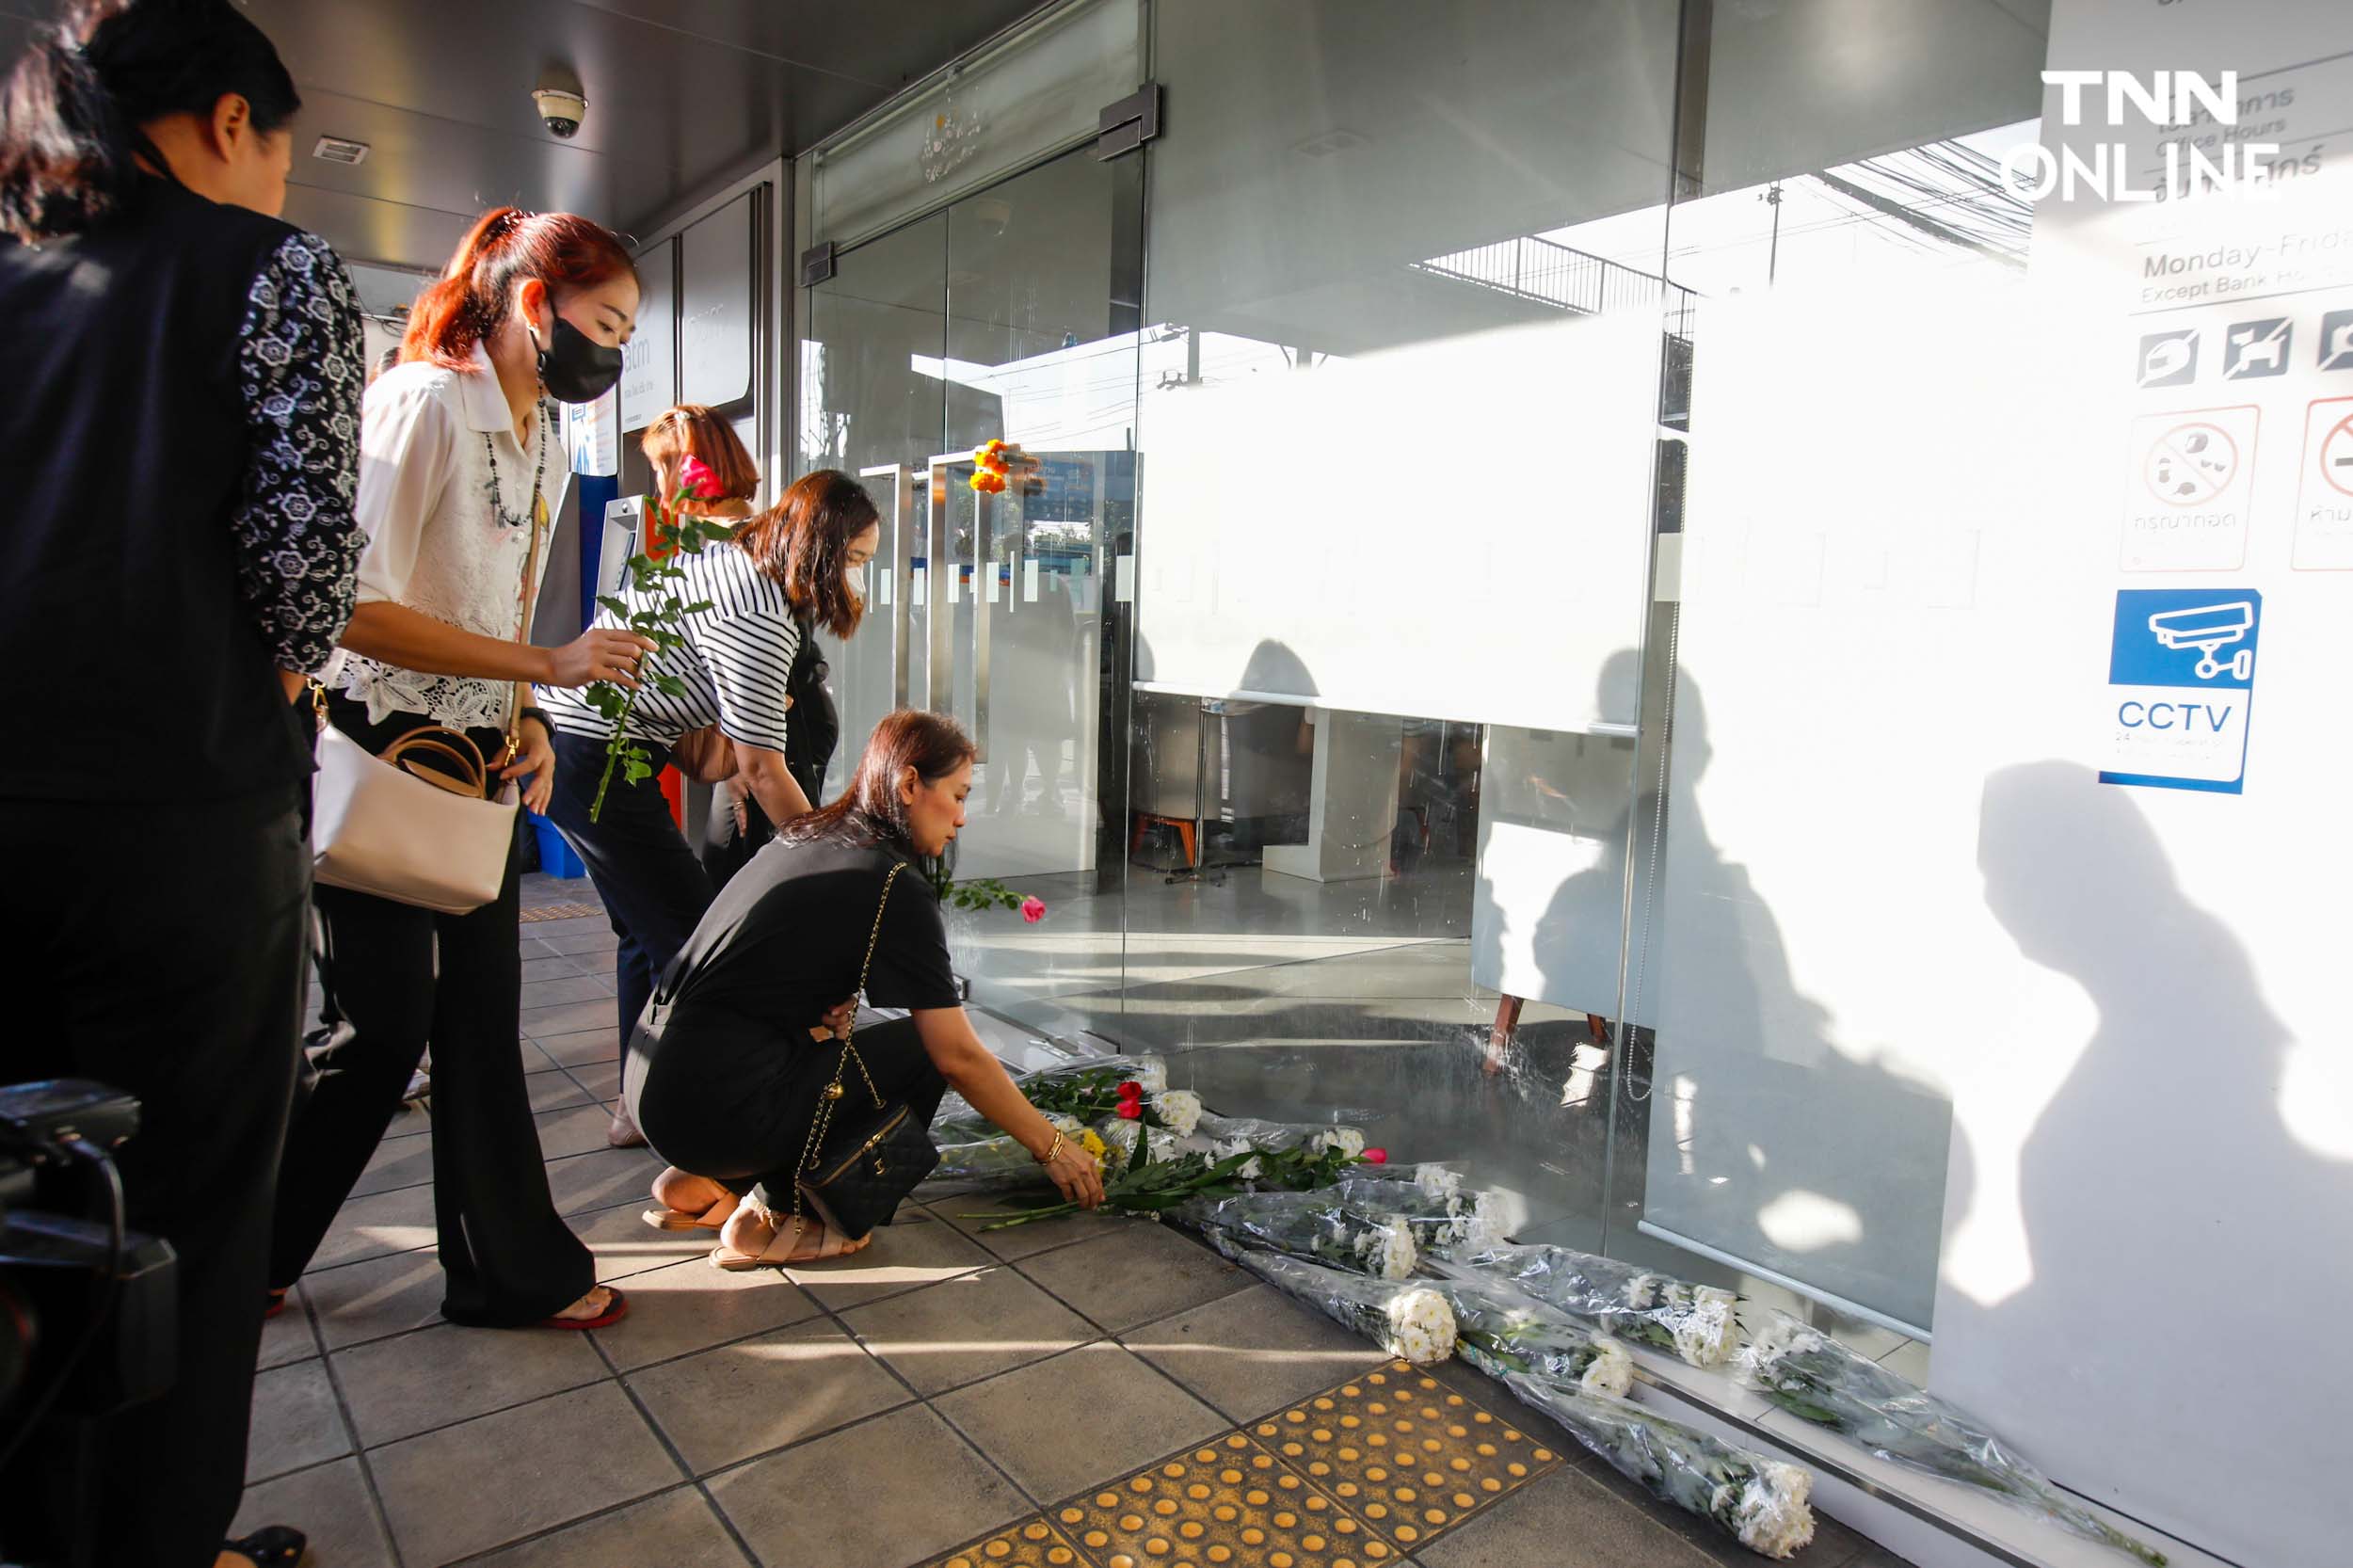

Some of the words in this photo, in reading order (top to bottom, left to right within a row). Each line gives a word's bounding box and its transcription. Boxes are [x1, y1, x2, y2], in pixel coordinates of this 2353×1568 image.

[2223, 119, 2285, 142] Hours
[2140, 281, 2209, 304] Except
[2216, 272, 2267, 295] Bank
[2118, 700, 2233, 732] CCTV
